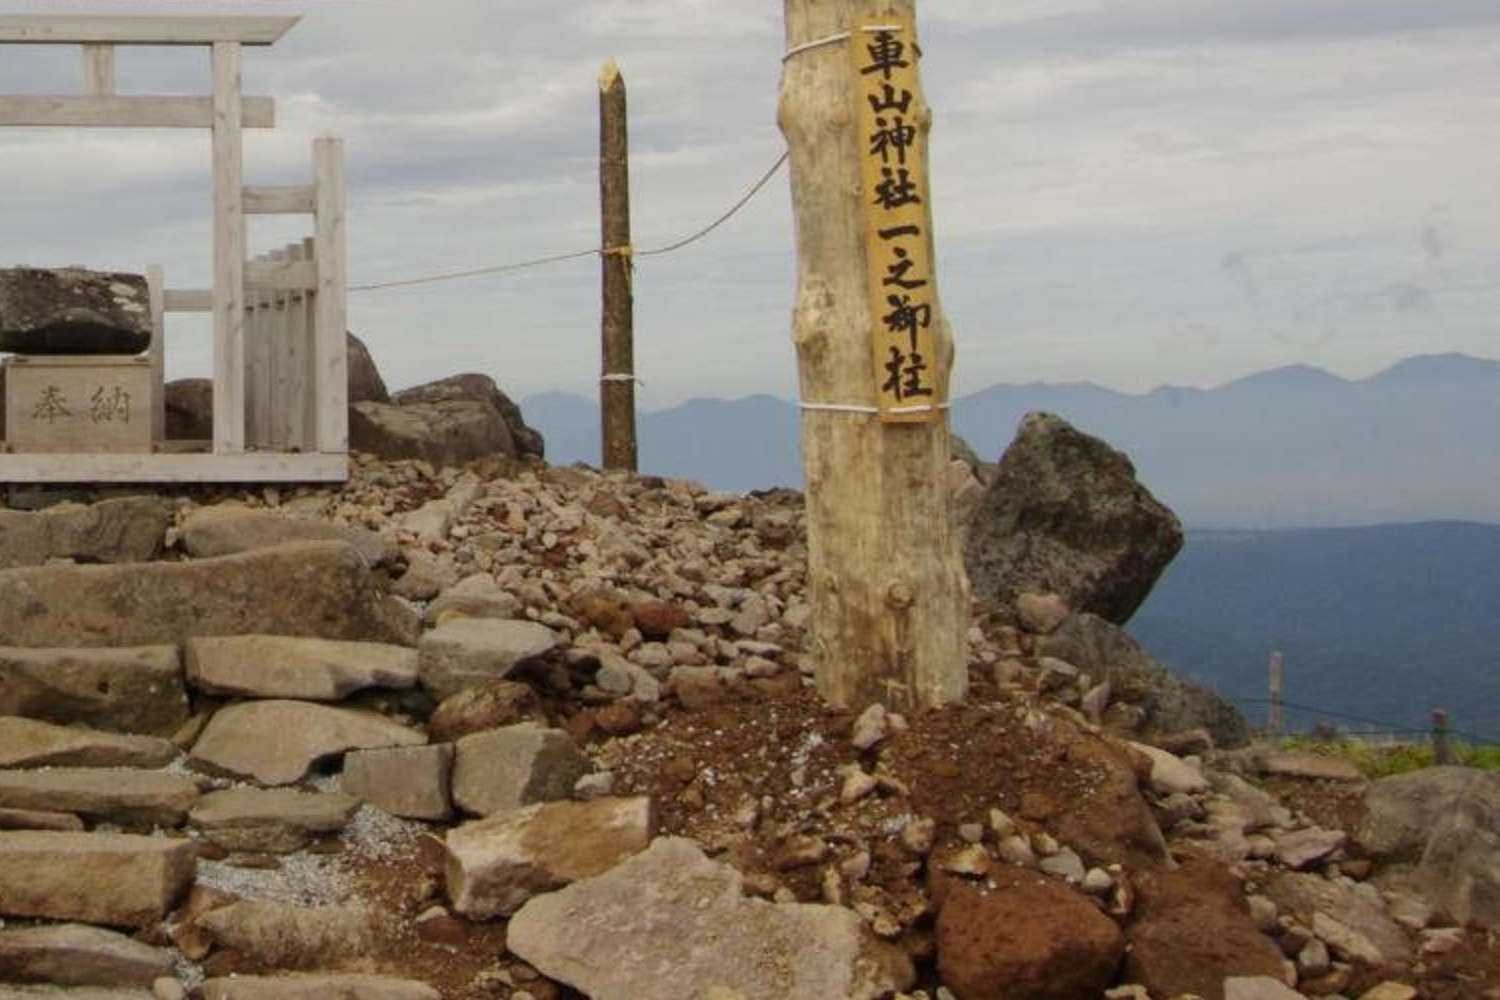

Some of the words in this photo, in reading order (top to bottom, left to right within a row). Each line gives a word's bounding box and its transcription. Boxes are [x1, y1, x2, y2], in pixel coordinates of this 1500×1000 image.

[860, 29, 933, 402] 車山神社一之御柱
[32, 385, 131, 424] 奉納
